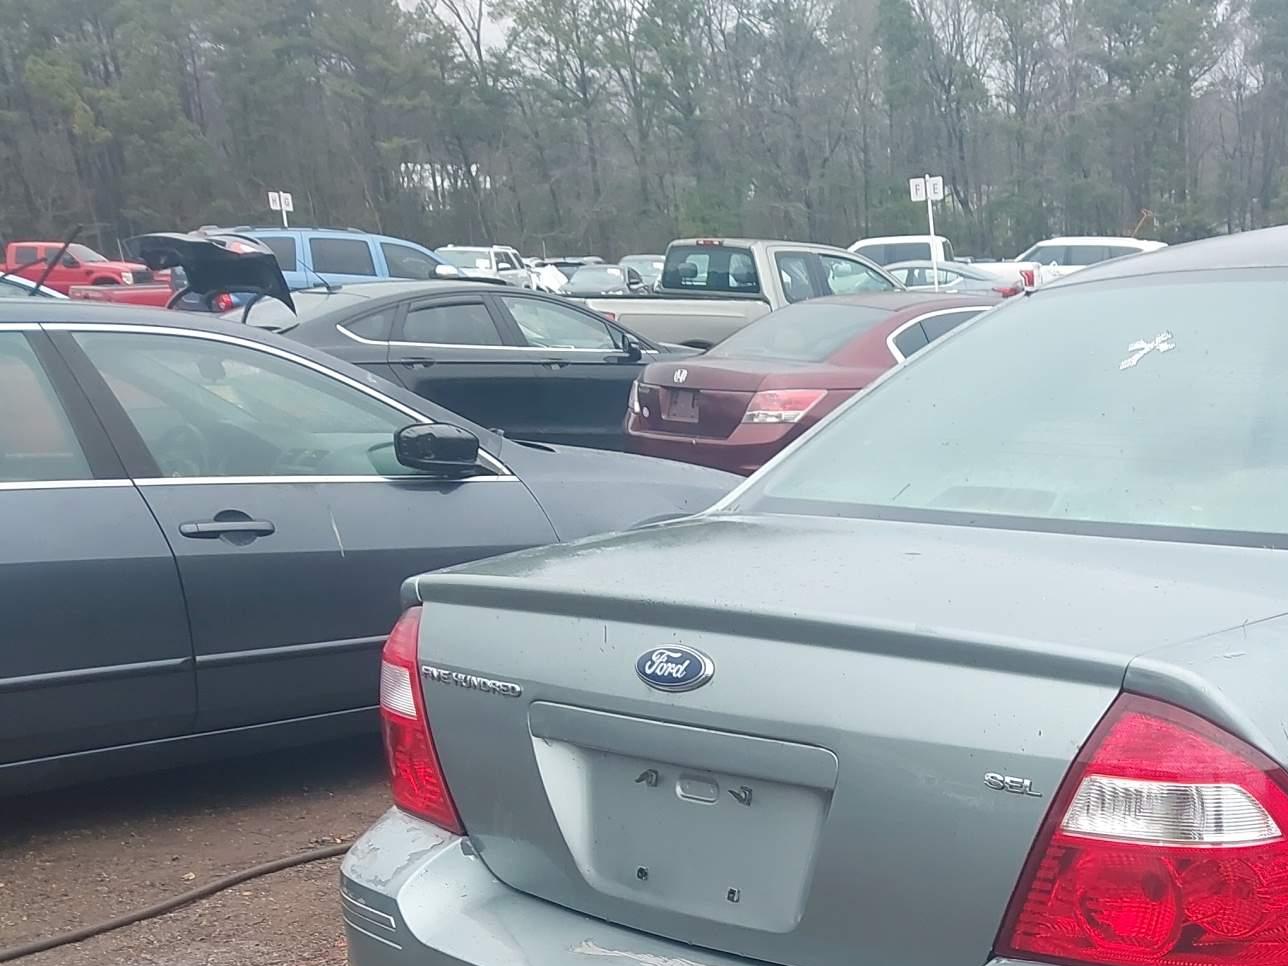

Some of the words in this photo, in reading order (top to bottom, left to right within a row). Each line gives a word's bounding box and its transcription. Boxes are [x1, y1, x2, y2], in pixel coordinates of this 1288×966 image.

[932, 181, 940, 194] E
[644, 649, 690, 678] Ford
[452, 672, 523, 698] HUNDRED
[983, 772, 1042, 798] SEL
